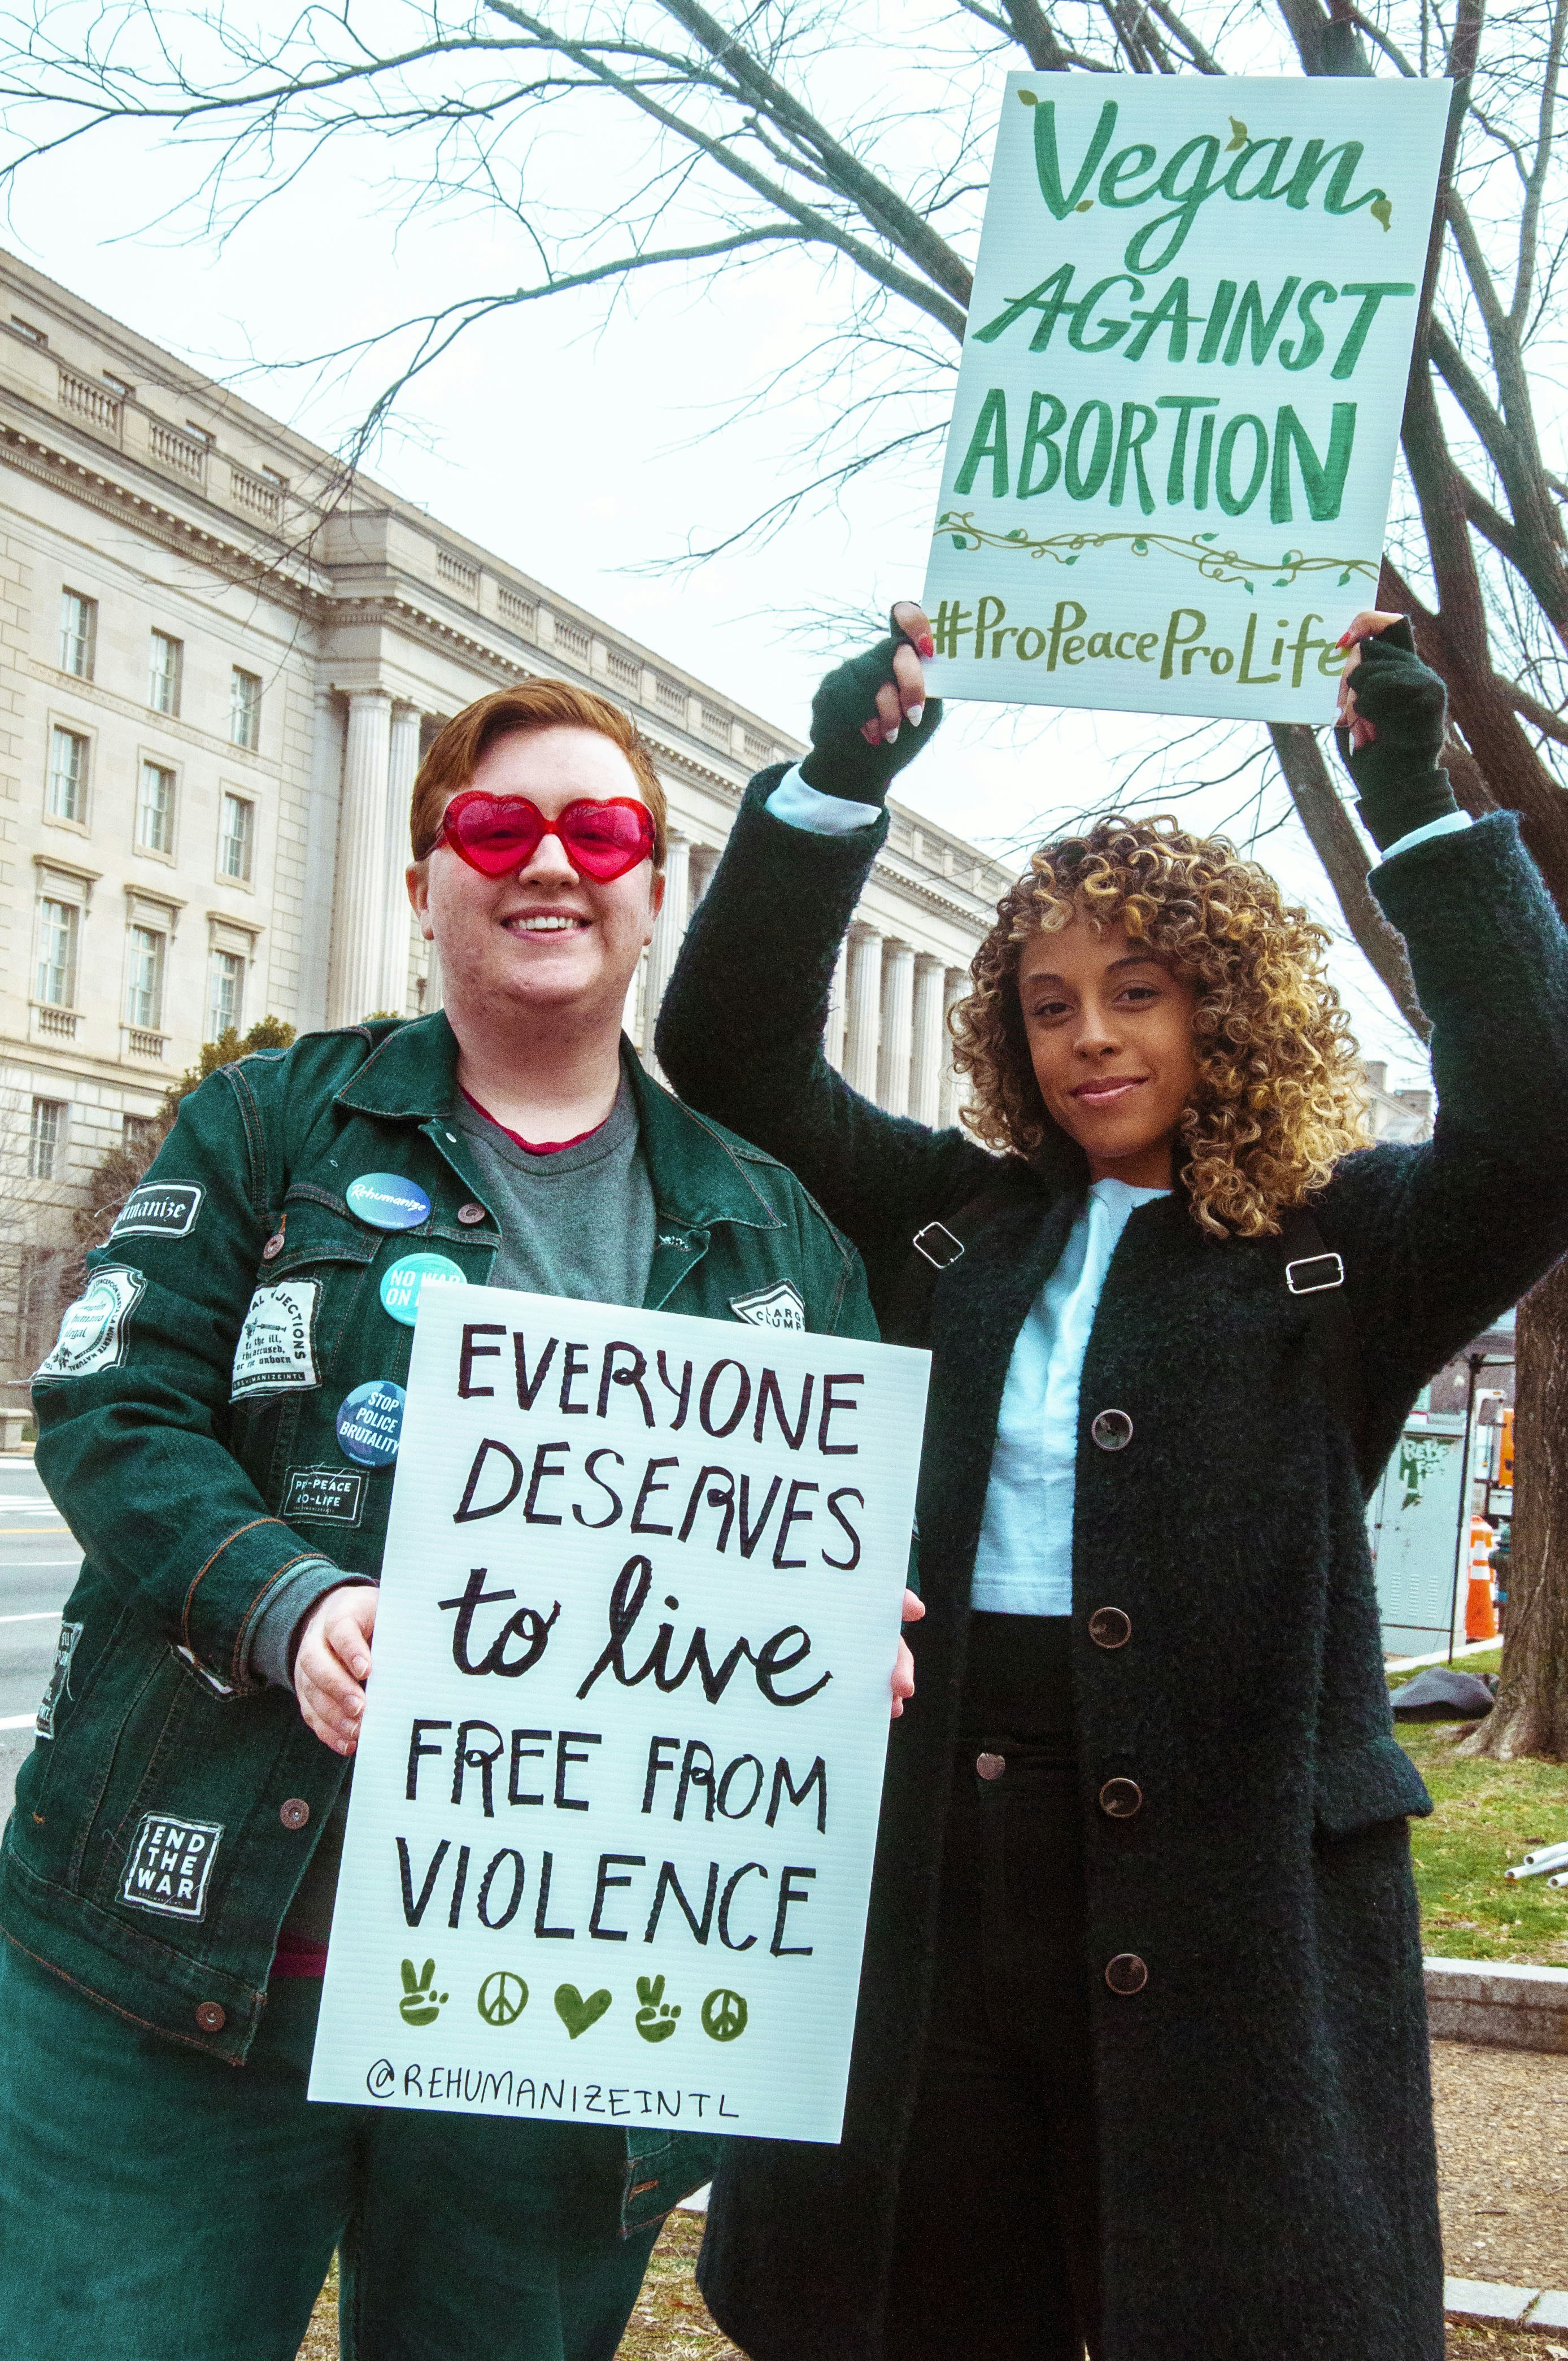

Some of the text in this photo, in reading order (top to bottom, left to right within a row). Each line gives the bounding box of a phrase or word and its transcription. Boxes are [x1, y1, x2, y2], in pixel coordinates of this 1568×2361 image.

[1034, 99, 1387, 276] Vegan
[972, 263, 1415, 380] AGAINST
[953, 389, 1357, 525] ABORTION
[351, 1184, 426, 1212] Rehumanize
[385, 1288, 412, 1306] ON
[390, 1269, 416, 1287] NO
[368, 1392, 399, 1412] STOP
[458, 1323, 865, 1456] EVERYONE
[339, 1421, 400, 1454] BRUTALITY
[355, 1407, 398, 1433] POLICE
[453, 1437, 865, 1571] DESERVES
[438, 1554, 833, 1706] to live
[406, 1719, 827, 1835] FREE FROM
[148, 1846, 197, 1876] THE
[151, 1826, 206, 1853] END
[138, 1867, 194, 1900] WAR
[395, 1837, 816, 1958] VIOLENCE
[366, 2059, 739, 2118] @REHUMANIZEINTL
